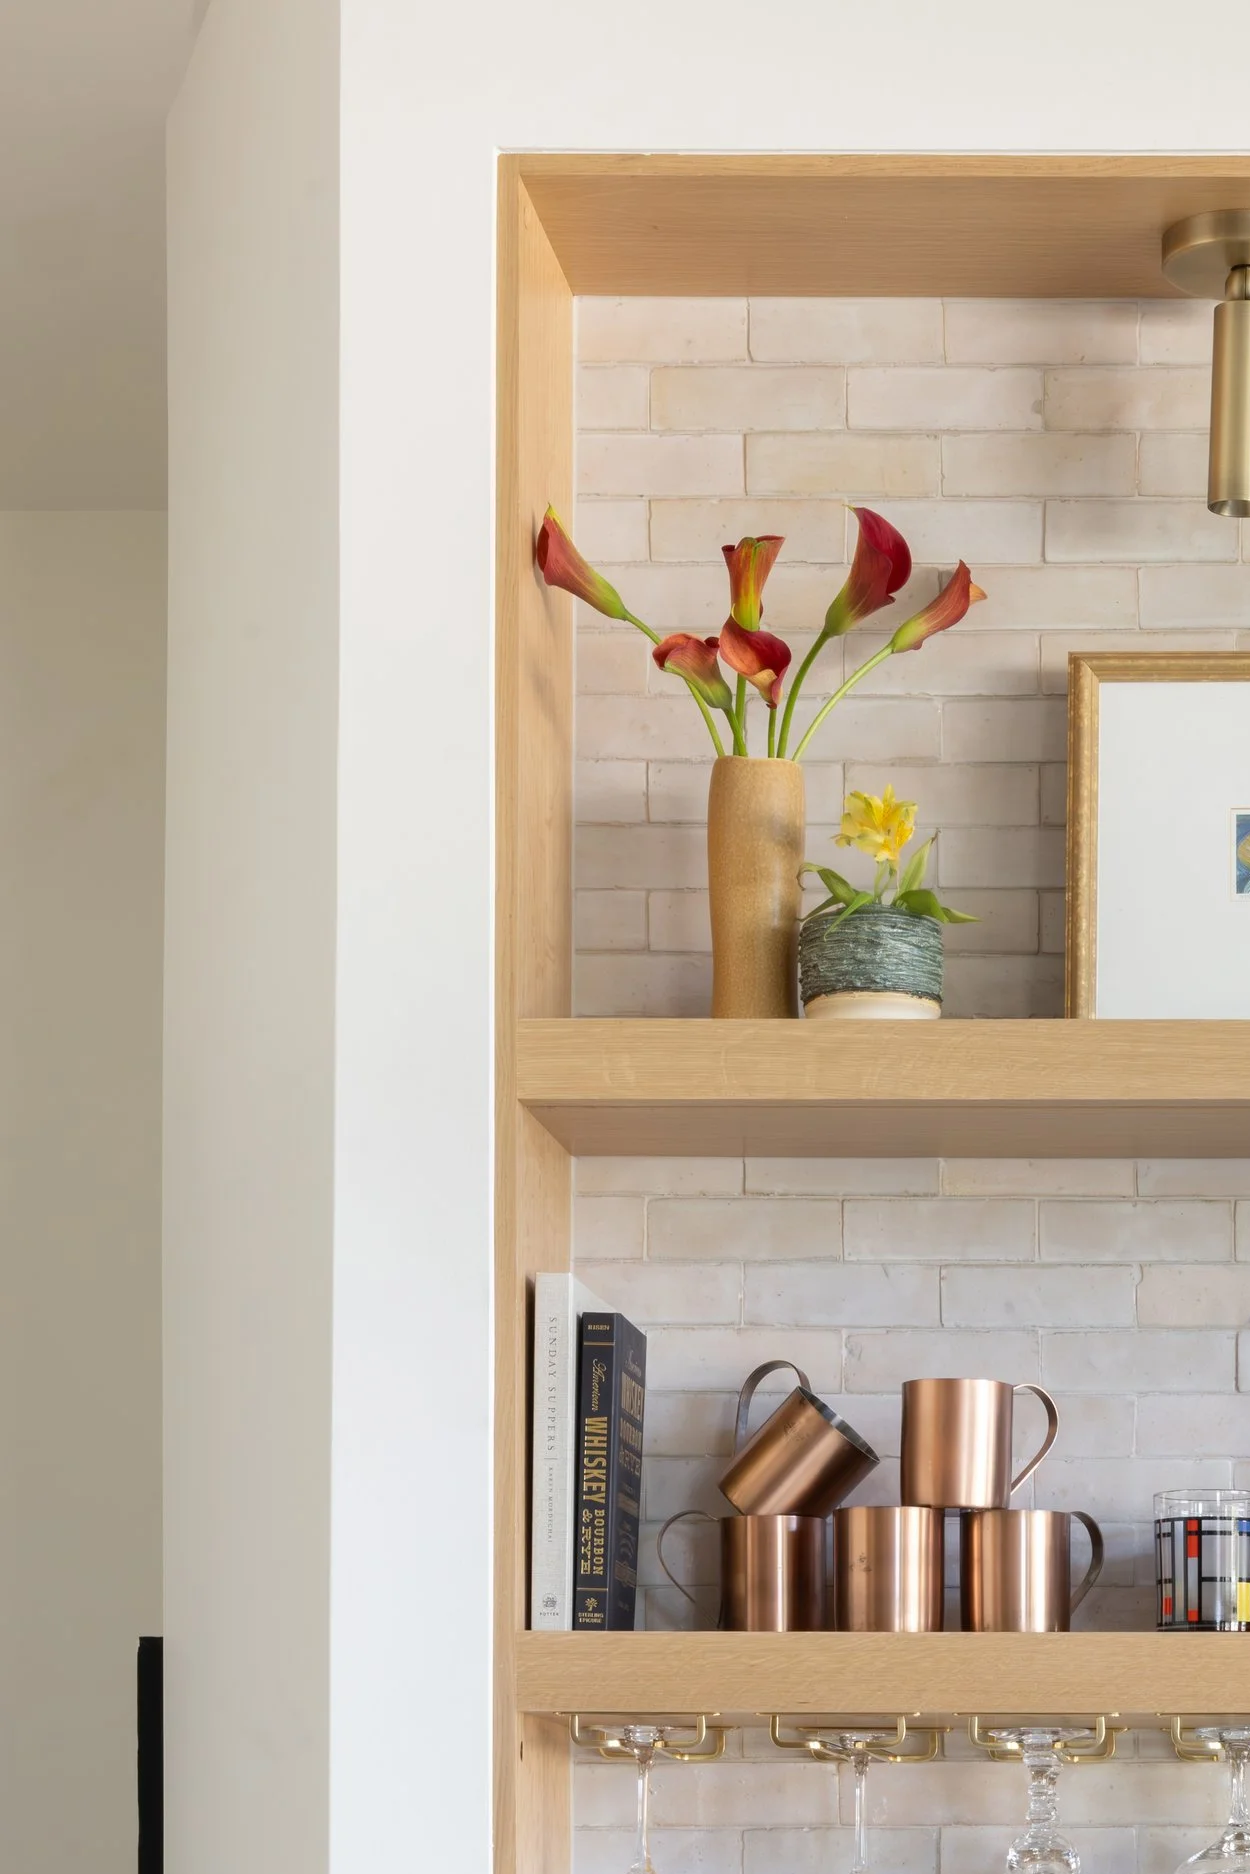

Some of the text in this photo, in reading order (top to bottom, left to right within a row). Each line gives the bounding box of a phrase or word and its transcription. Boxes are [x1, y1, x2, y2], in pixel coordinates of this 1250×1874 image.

[548, 1316, 557, 1378] SUNDAY
[547, 1386, 557, 1452] SUPPERS
[583, 1358, 608, 1576] American WHISKEY BOURBON
[580, 1508, 593, 1575] & RYE
